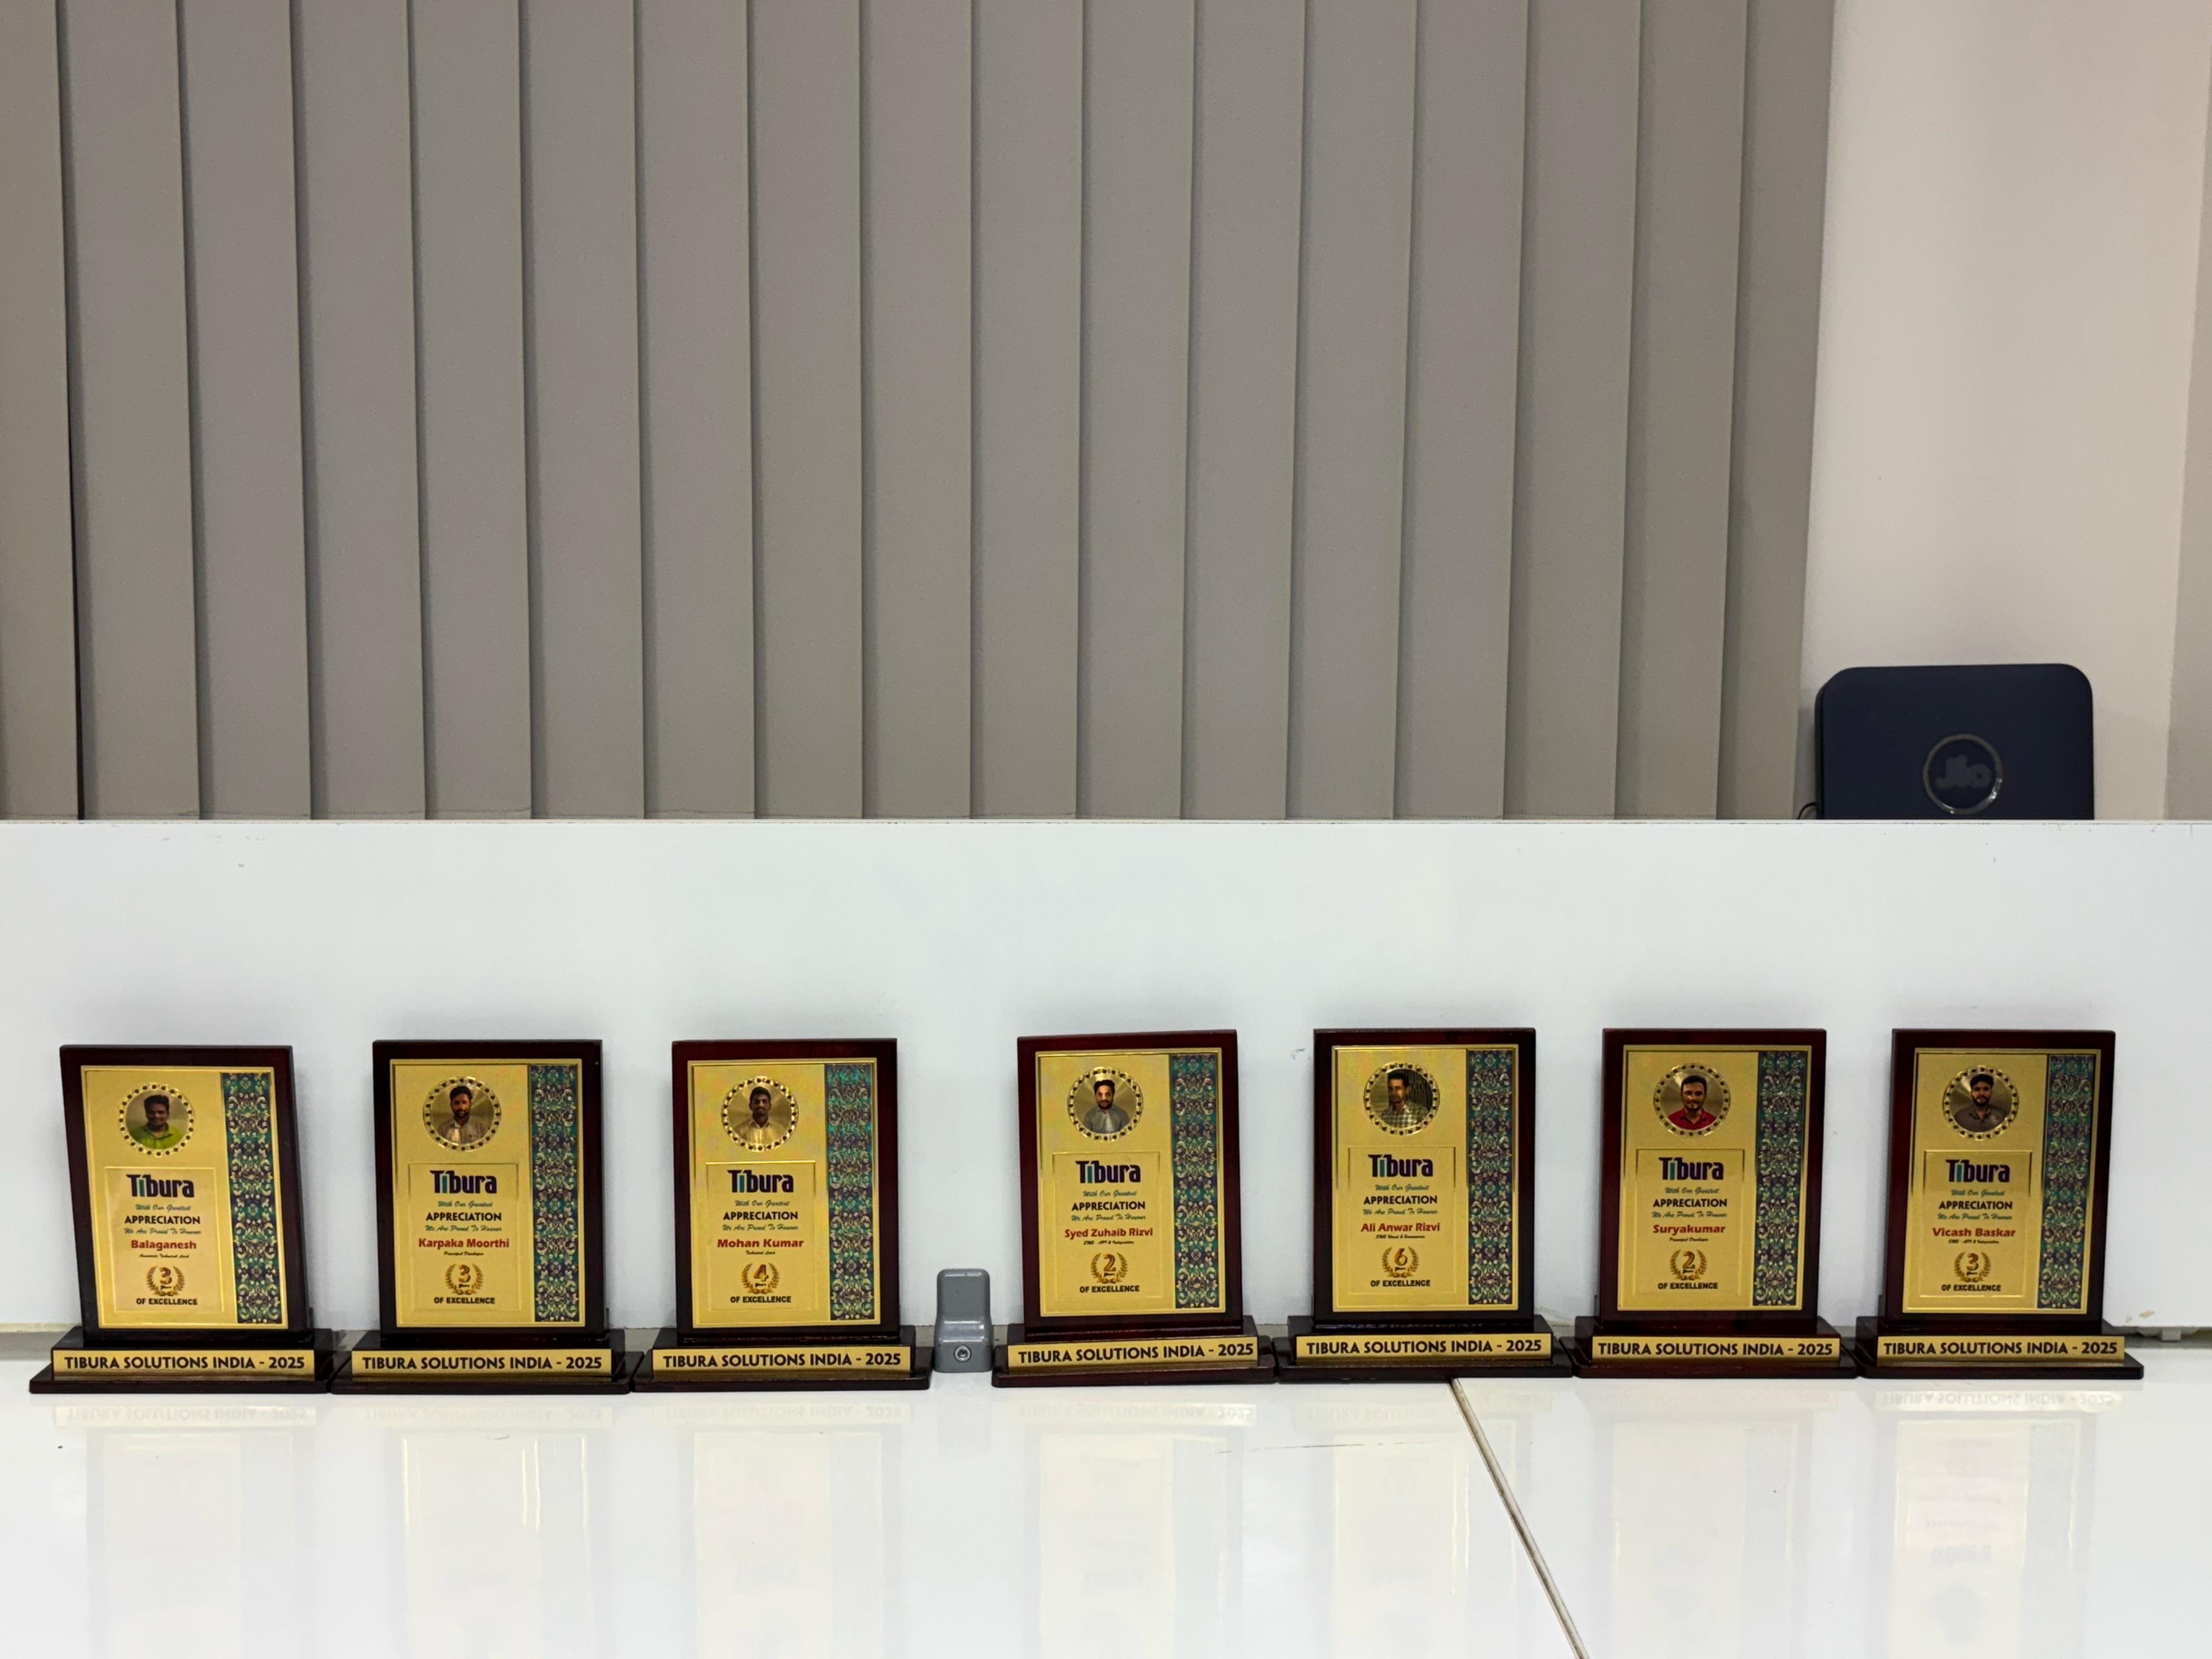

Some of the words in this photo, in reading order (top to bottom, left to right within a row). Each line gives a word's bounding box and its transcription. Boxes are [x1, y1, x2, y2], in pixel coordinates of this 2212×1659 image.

[1075, 1161, 1141, 1183] Tibura
[1368, 1154, 1433, 1177] Tibura
[1658, 1157, 1723, 1180] Tibura
[1945, 1159, 2010, 1182] Tibura
[126, 1174, 194, 1197] Tibura
[430, 1170, 497, 1194] Tibura
[727, 1170, 794, 1193] Tibura
[1072, 1201, 1145, 1210] APPRECIATION
[1364, 1196, 1437, 1204] APPRECIATION
[1653, 1199, 1727, 1207] APPRECIATION
[1939, 1201, 2012, 1210] APPRECIATION
[125, 1216, 200, 1224] APPRECIATION
[426, 1212, 501, 1221] APPRECIATION
[724, 1212, 798, 1220] APPRECIATION
[1065, 1229, 1088, 1239] Syed
[1091, 1228, 1126, 1237] Zuhaib
[1130, 1228, 1153, 1236] Rizvi
[1361, 1223, 1375, 1232] Ali
[1416, 1223, 1440, 1231] Rizvi
[1653, 1224, 1725, 1235] Suryakumar
[1933, 1228, 1971, 1237] Vicash
[1975, 1228, 2016, 1237] Baskar
[132, 1240, 196, 1251] Balaganesh
[419, 1238, 463, 1249] Karpaka
[467, 1239, 509, 1248] Moorthi
[718, 1239, 759, 1248] Mohan
[764, 1239, 804, 1247] Kumar
[1103, 1254, 1116, 1272] 2
[1395, 1249, 1407, 1266] 6
[1683, 1251, 1695, 1269] 2
[1967, 1253, 1978, 1271] 3
[160, 1267, 172, 1284] 3
[459, 1265, 471, 1283] 3
[754, 1265, 769, 1282] 4
[1018, 1350, 1073, 1363] TIBURA
[1076, 1347, 1160, 1361] SOLUTIONS
[1164, 1345, 1205, 1358] INDIA
[1218, 1344, 1253, 1356] 2025
[1306, 1342, 1361, 1354] TIBURA
[1364, 1341, 1447, 1353] SOLUTIONS
[1452, 1340, 1493, 1352] INDIA
[1506, 1340, 1542, 1351] 2025
[1598, 1343, 1653, 1355] TIBURA
[1656, 1343, 1739, 1355] SOLUTIONS
[1743, 1343, 1784, 1355] INDIA
[1797, 1343, 1832, 1355] 2025
[1884, 1343, 1938, 1355] TIBURA
[1940, 1342, 2023, 1354] SOLUTIONS
[2027, 1342, 2068, 1353] INDIA
[2081, 1342, 2117, 1354] 2025
[65, 1356, 122, 1369] TIBURA
[125, 1356, 210, 1369] SOLUTIONS
[213, 1357, 255, 1369] INDIA
[269, 1357, 304, 1368] 2025
[363, 1357, 419, 1369] TIBURA
[421, 1357, 506, 1369] SOLUTIONS
[510, 1357, 552, 1369] INDIA
[566, 1357, 601, 1368] 2025
[663, 1356, 719, 1367] TIBURA
[722, 1355, 806, 1367] SOLUTIONS
[810, 1354, 851, 1365] INDIA
[866, 1353, 901, 1364] 2025
